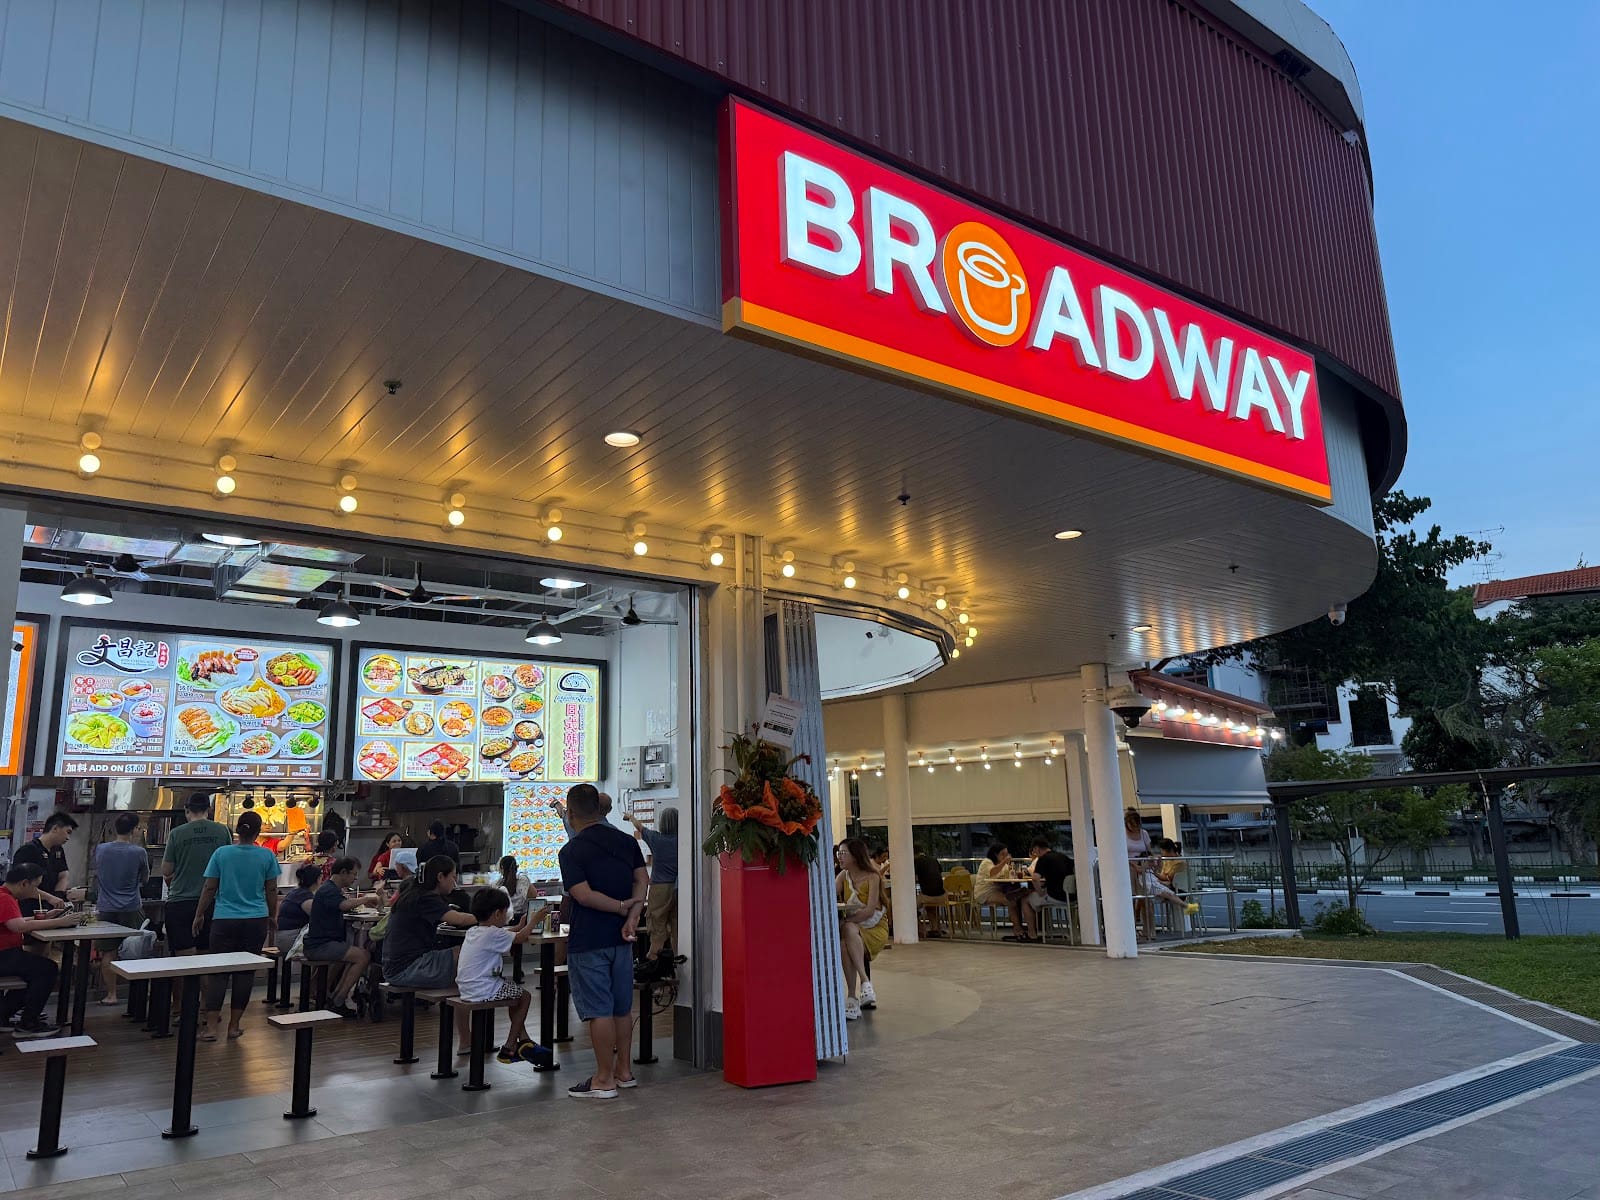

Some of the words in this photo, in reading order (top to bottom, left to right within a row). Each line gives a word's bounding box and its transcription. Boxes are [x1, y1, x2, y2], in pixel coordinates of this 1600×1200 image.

[65, 762, 87, 773] 加料
[89, 764, 108, 772] ADD
[110, 764, 123, 772] ON
[125, 764, 146, 773] $1.00
